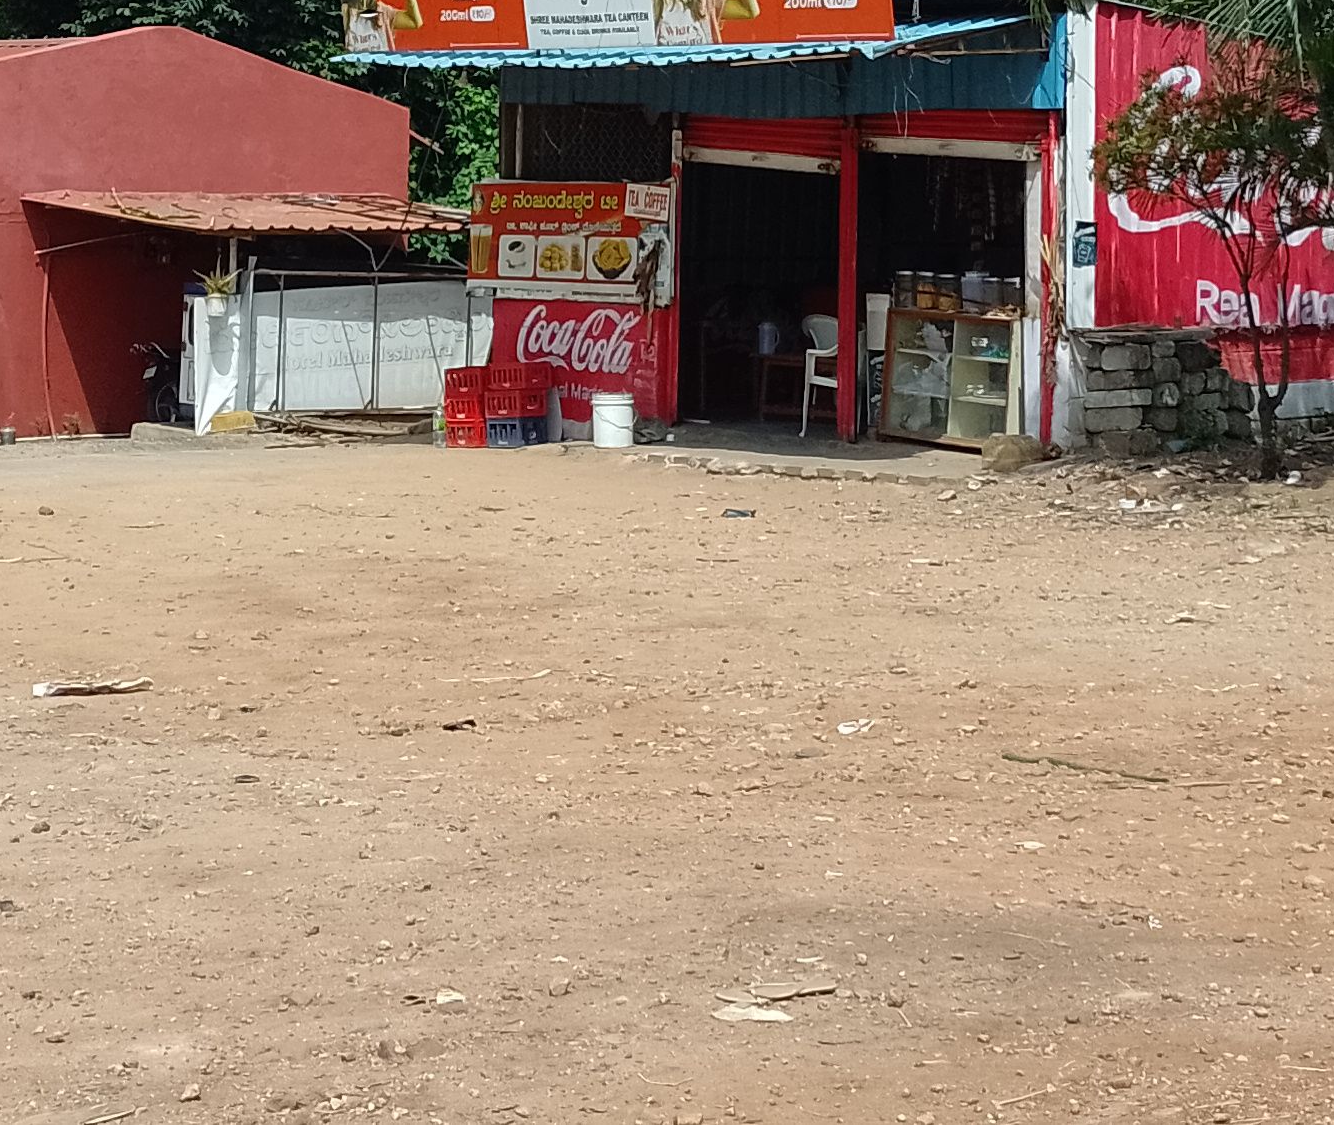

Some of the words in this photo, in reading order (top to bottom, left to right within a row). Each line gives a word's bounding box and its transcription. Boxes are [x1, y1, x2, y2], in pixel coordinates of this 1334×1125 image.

[439, 9, 468, 22] 200ml
[490, 190, 507, 215] ಶ್ರೀ
[512, 189, 595, 220] ನಂಜುಂಡೇಶ್ವರ
[628, 189, 639, 207] TEA
[643, 191, 668, 211] COFFEE
